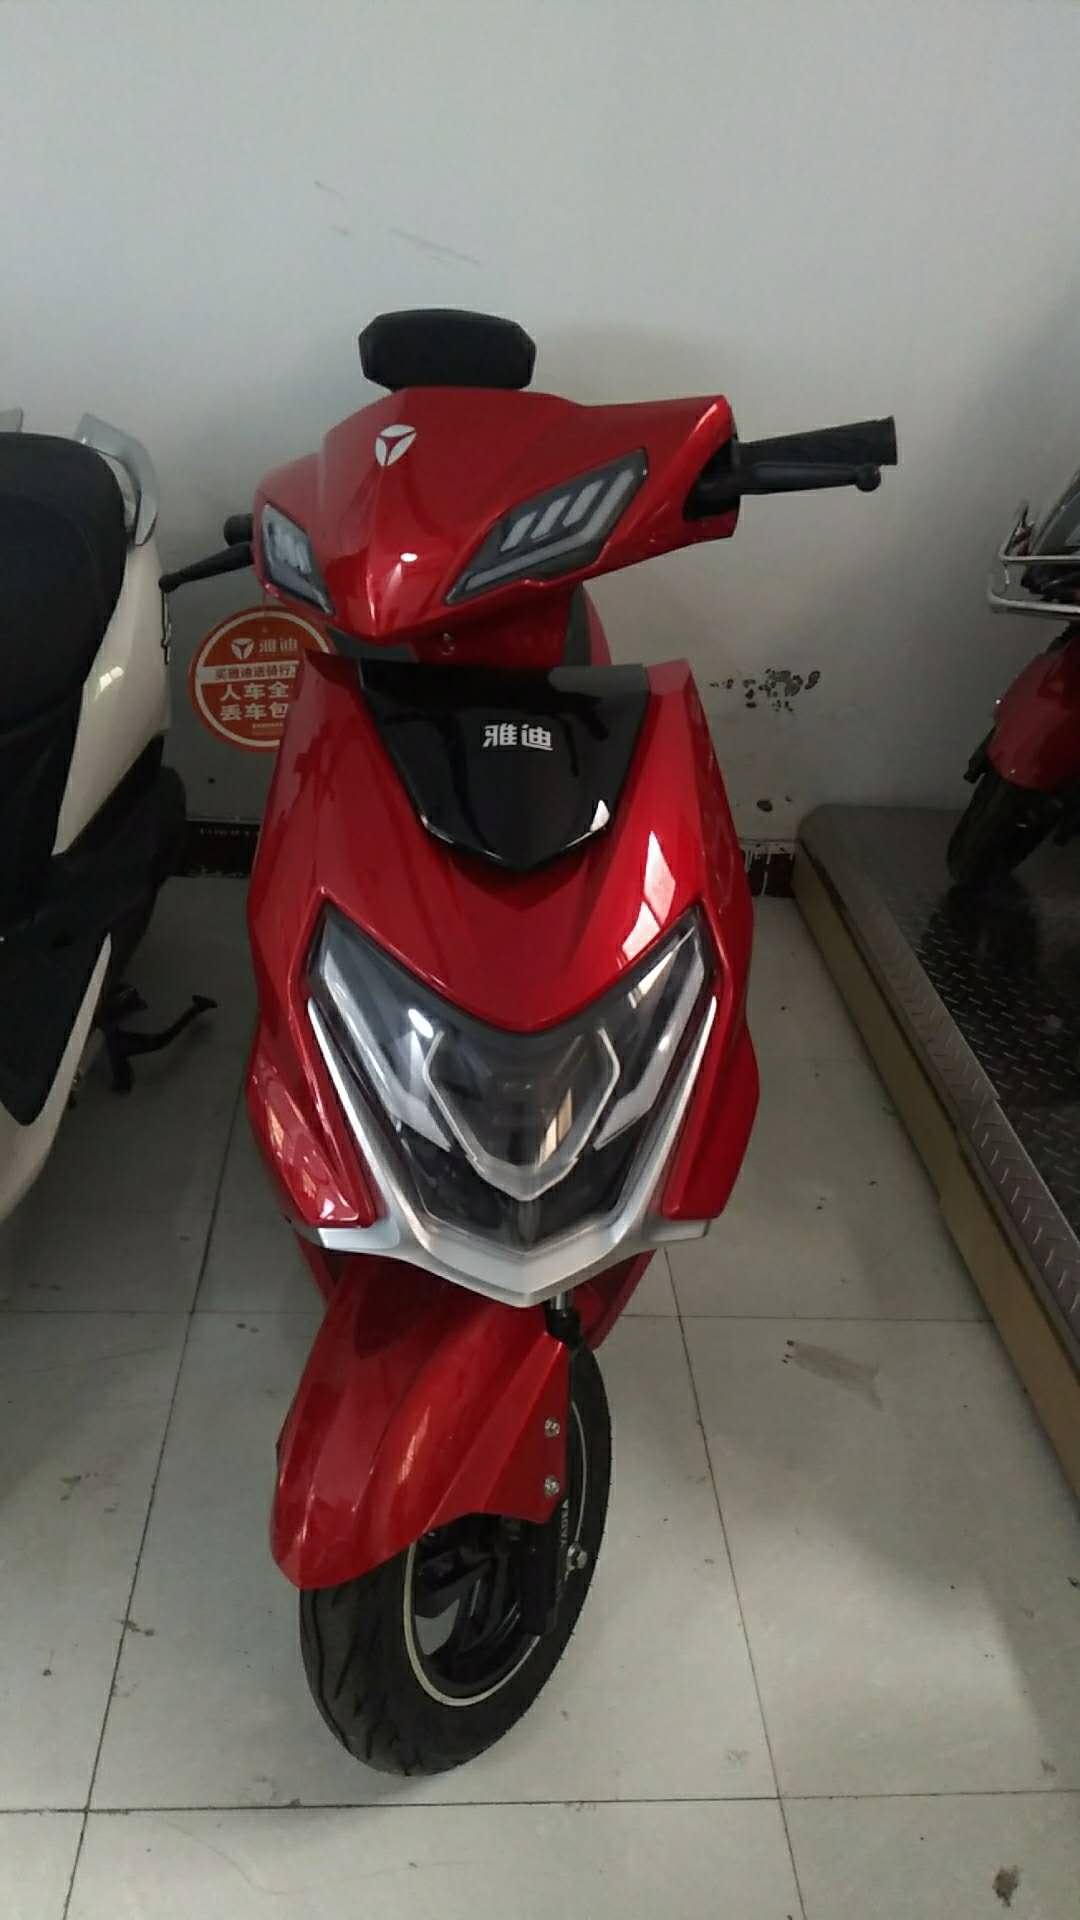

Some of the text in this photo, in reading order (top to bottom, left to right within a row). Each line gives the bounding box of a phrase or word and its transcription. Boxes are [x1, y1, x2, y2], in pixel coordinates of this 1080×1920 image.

[258, 637, 298, 653] 雅迪
[220, 680, 289, 702] 人车全
[220, 702, 289, 721] 丢车包
[482, 722, 553, 751] 雅迪
